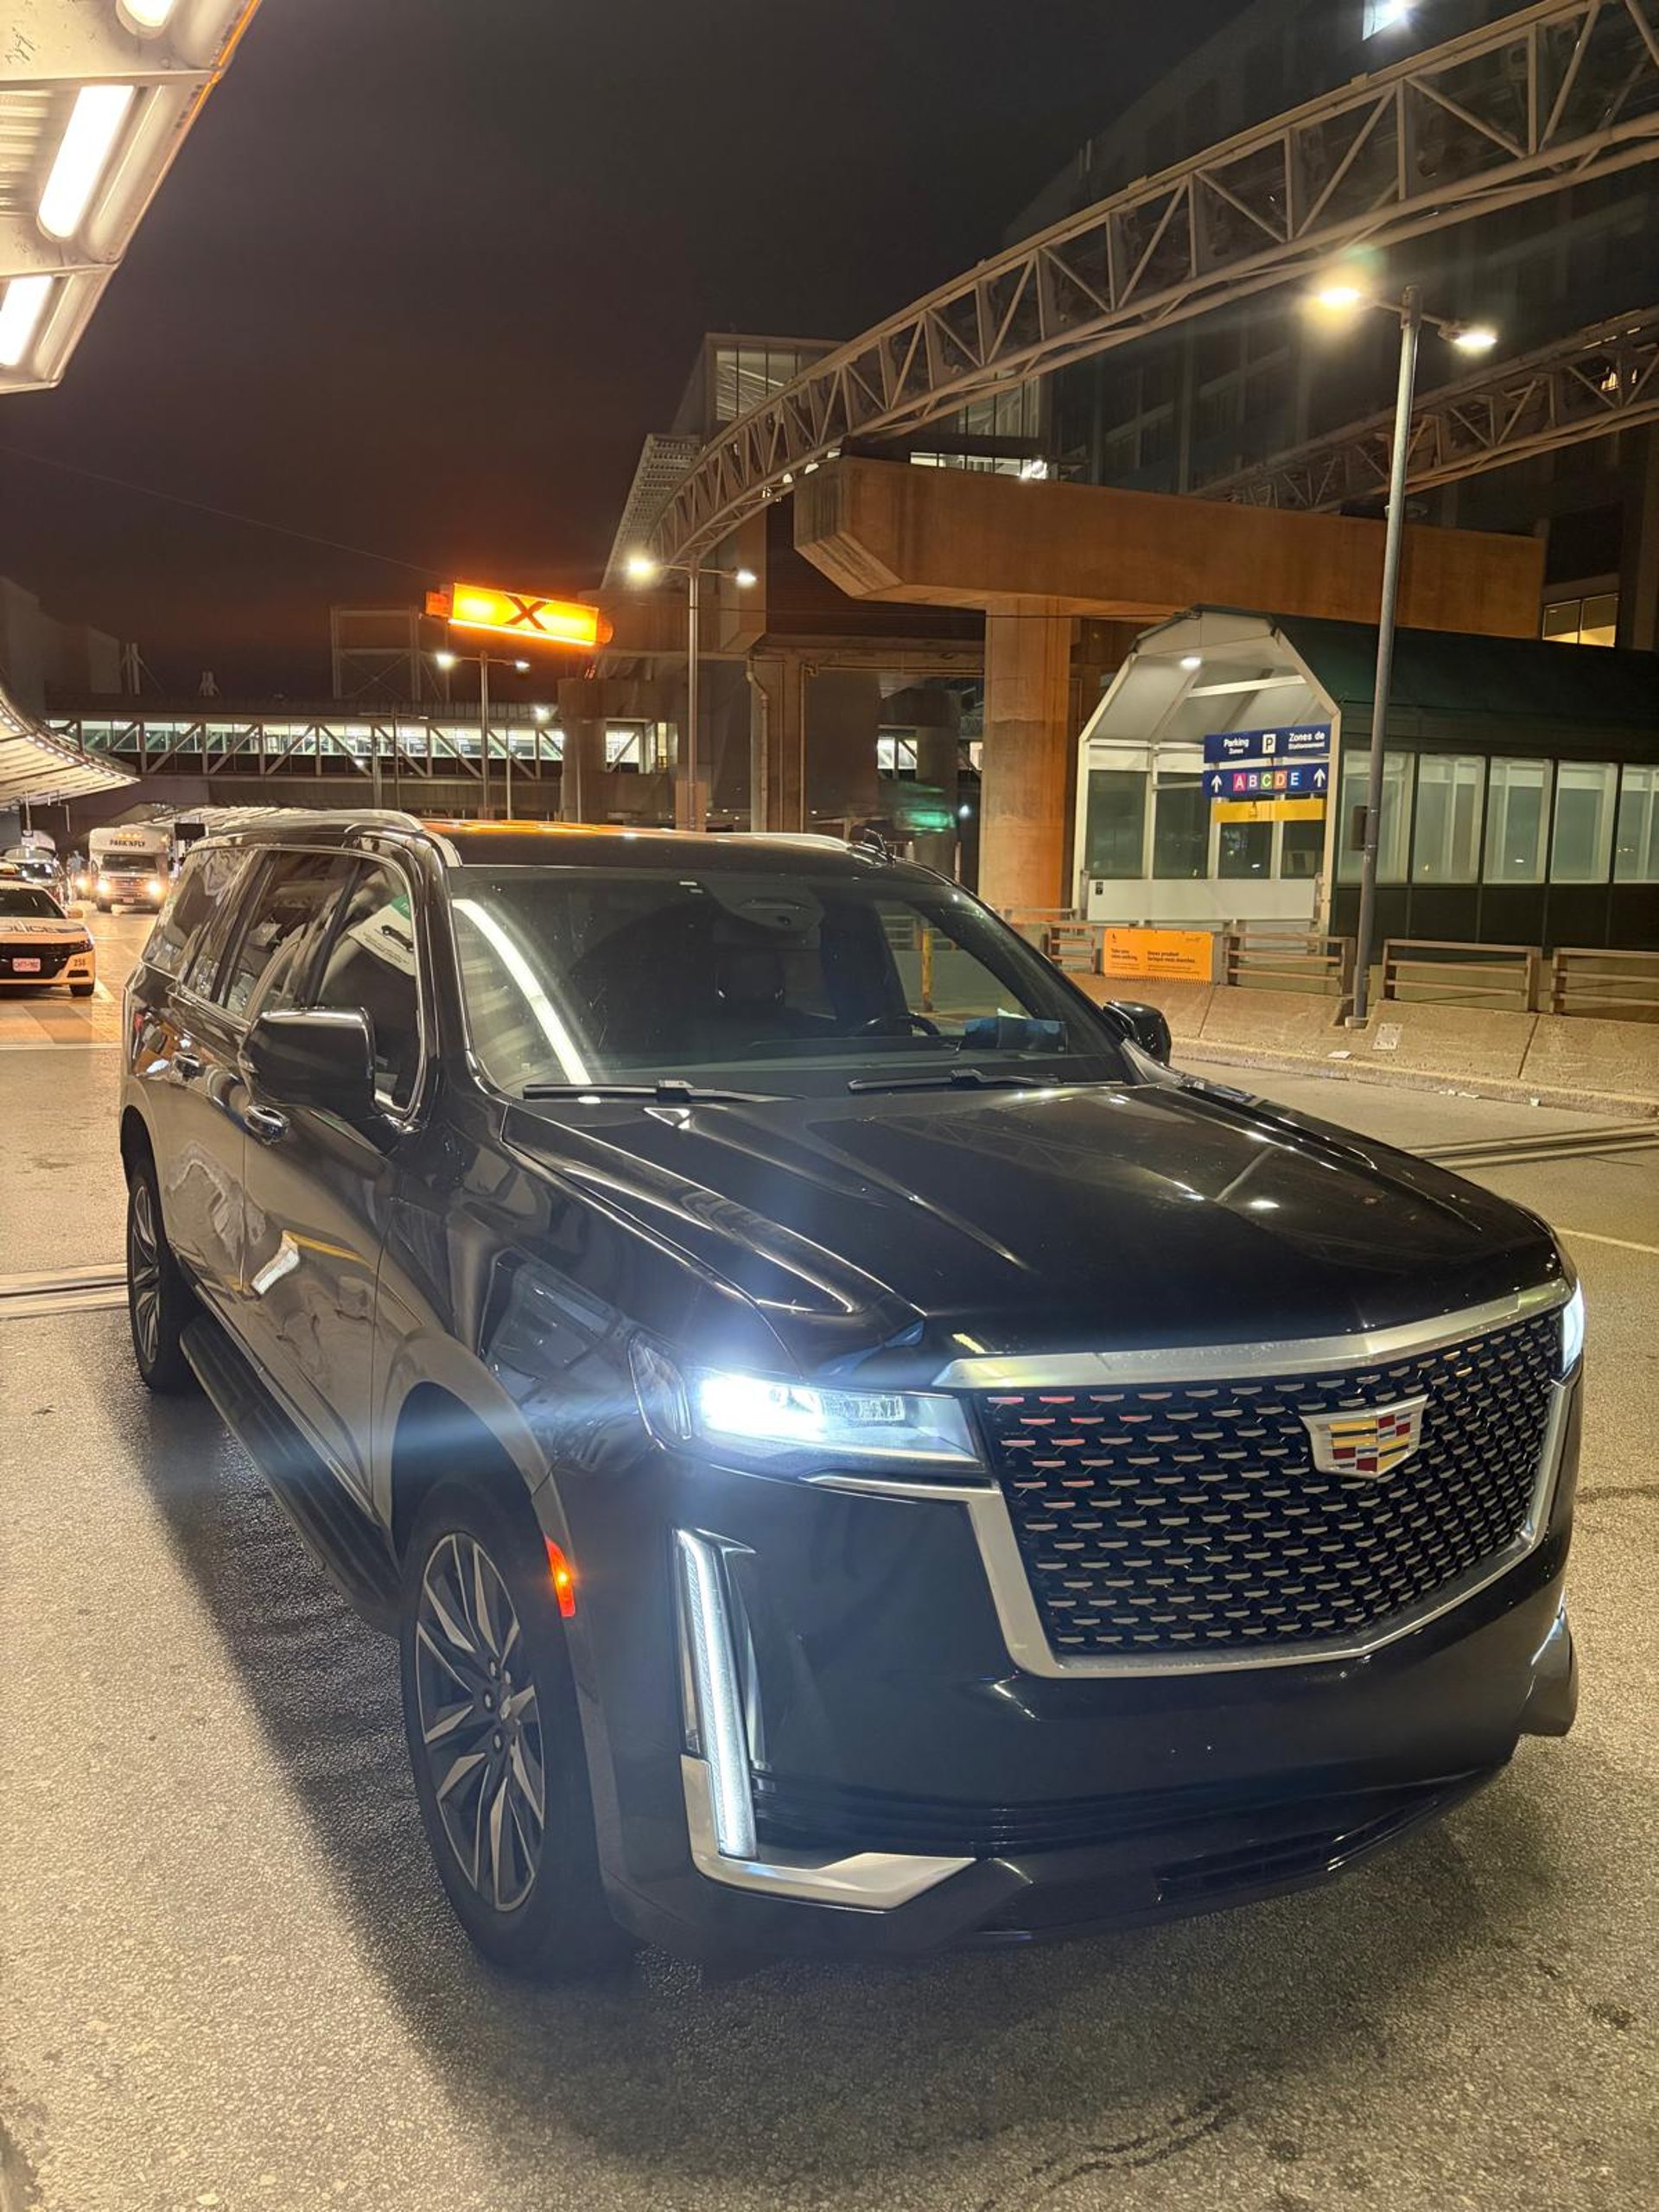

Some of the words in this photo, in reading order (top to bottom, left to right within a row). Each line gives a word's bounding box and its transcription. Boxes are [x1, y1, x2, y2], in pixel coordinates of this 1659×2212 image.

[1288, 733, 1313, 741] Zones
[1314, 731, 1325, 741] de
[1224, 737, 1249, 748] Parking
[1235, 779, 1244, 789] A
[1249, 776, 1258, 787] B
[1262, 774, 1272, 787] C
[1275, 773, 1286, 786] D
[1290, 772, 1300, 786] E
